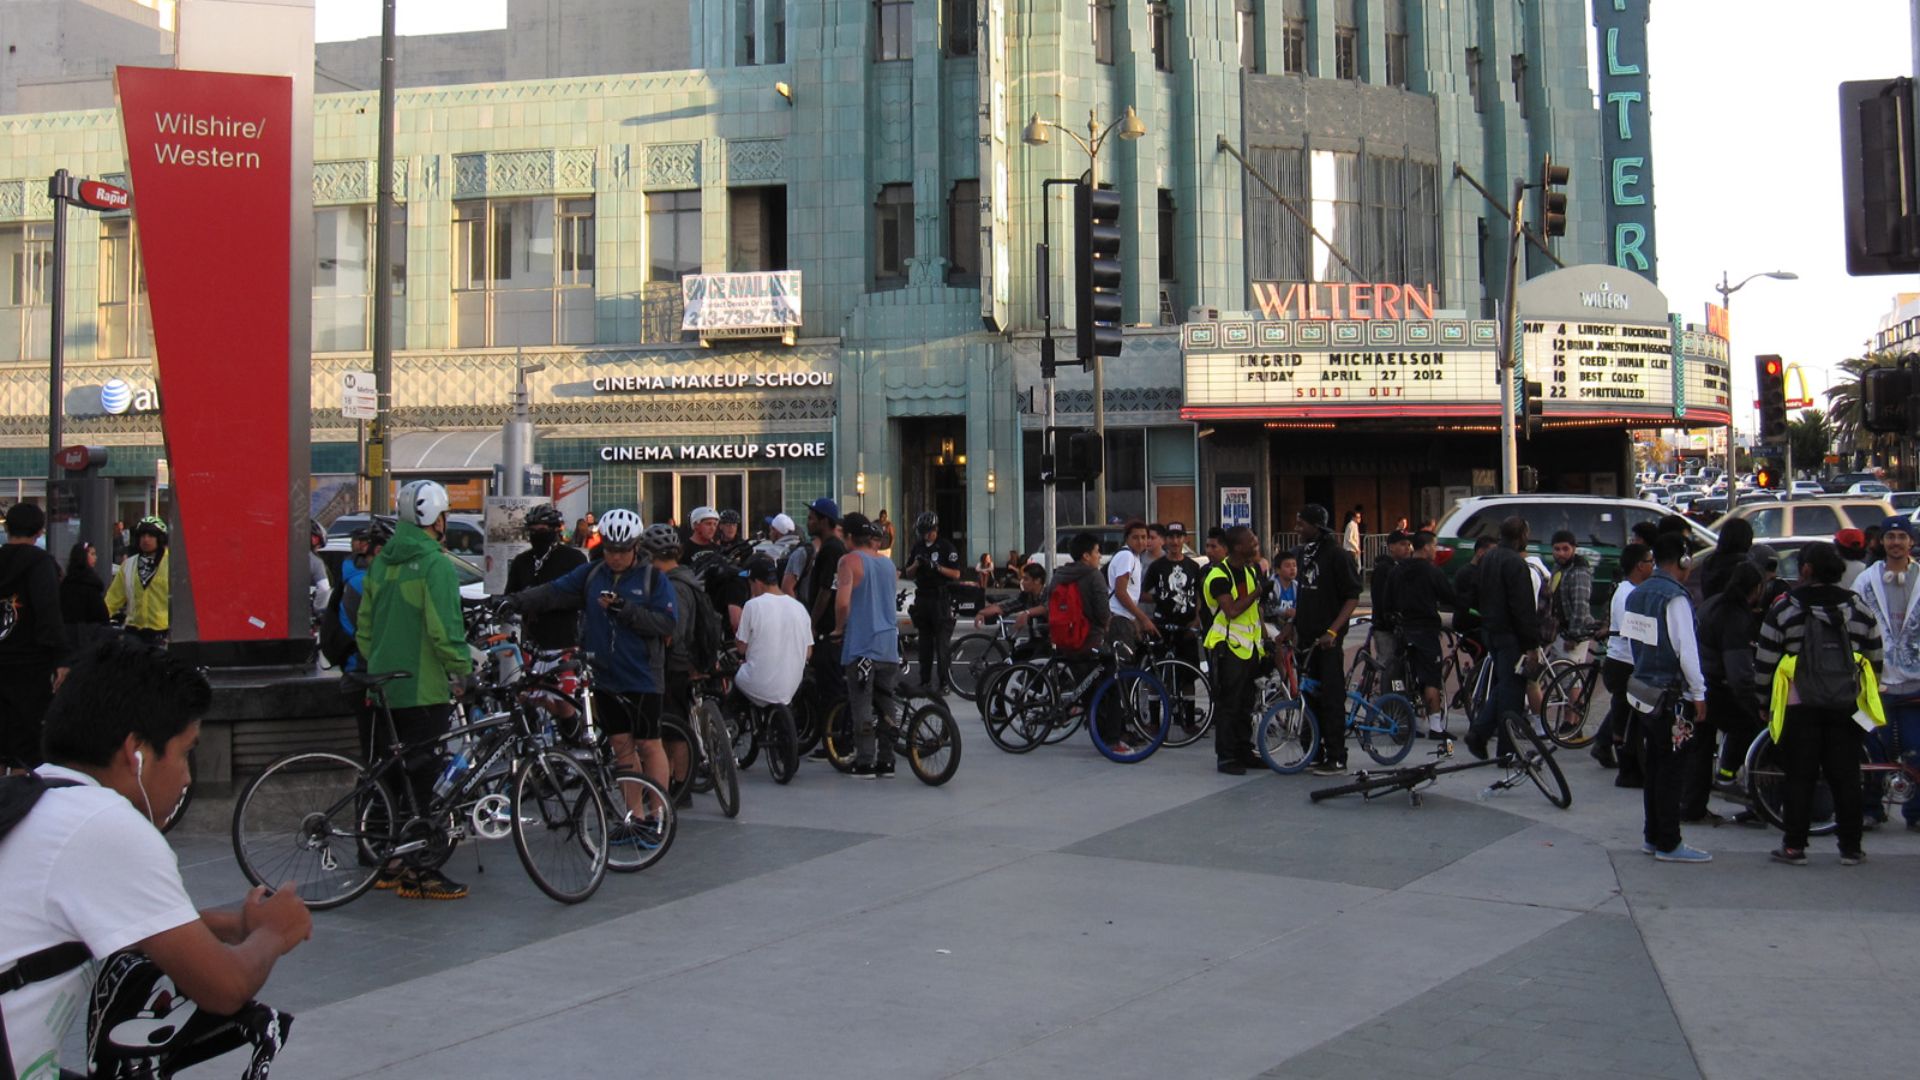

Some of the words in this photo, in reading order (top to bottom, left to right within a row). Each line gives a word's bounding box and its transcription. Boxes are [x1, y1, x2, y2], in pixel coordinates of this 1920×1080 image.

[155, 112, 266, 139] Wilshire/
[1606, 0, 1649, 270] LTER
[155, 143, 260, 169] Western
[96, 187, 127, 206] Rapid
[1252, 282, 1434, 320] WILTERN
[1580, 291, 1628, 309] WILTERN
[1523, 323, 1545, 334] MAY
[1557, 323, 1566, 335] 4
[1578, 324, 1615, 336] LINDSEY
[1553, 339, 1566, 351] 12
[1596, 341, 1640, 353] JONESTOWN
[1240, 354, 1303, 367] INGRID
[1329, 353, 1443, 366] MICHAELSON
[1553, 354, 1565, 367] 15
[1579, 356, 1608, 367] CREED
[1617, 357, 1644, 368] HUMAN
[592, 376, 666, 392] CINEMA
[671, 373, 750, 390] MAKEUP
[755, 371, 833, 388] SCHOOL
[1247, 371, 1295, 382] FRIDAY
[1321, 370, 1362, 381] APRIL
[1381, 371, 1397, 381] 27
[1413, 370, 1443, 380] 2012
[1580, 372, 1603, 382] BEST
[1612, 372, 1639, 383] COAST
[1296, 387, 1342, 398] SOLD
[1369, 387, 1403, 397] OUT
[1550, 386, 1567, 398] 22
[1580, 387, 1644, 399] SPIRITUALIZED
[600, 445, 674, 461] CINEMA
[680, 443, 759, 460] MAKEUP
[765, 442, 826, 459] STORE
